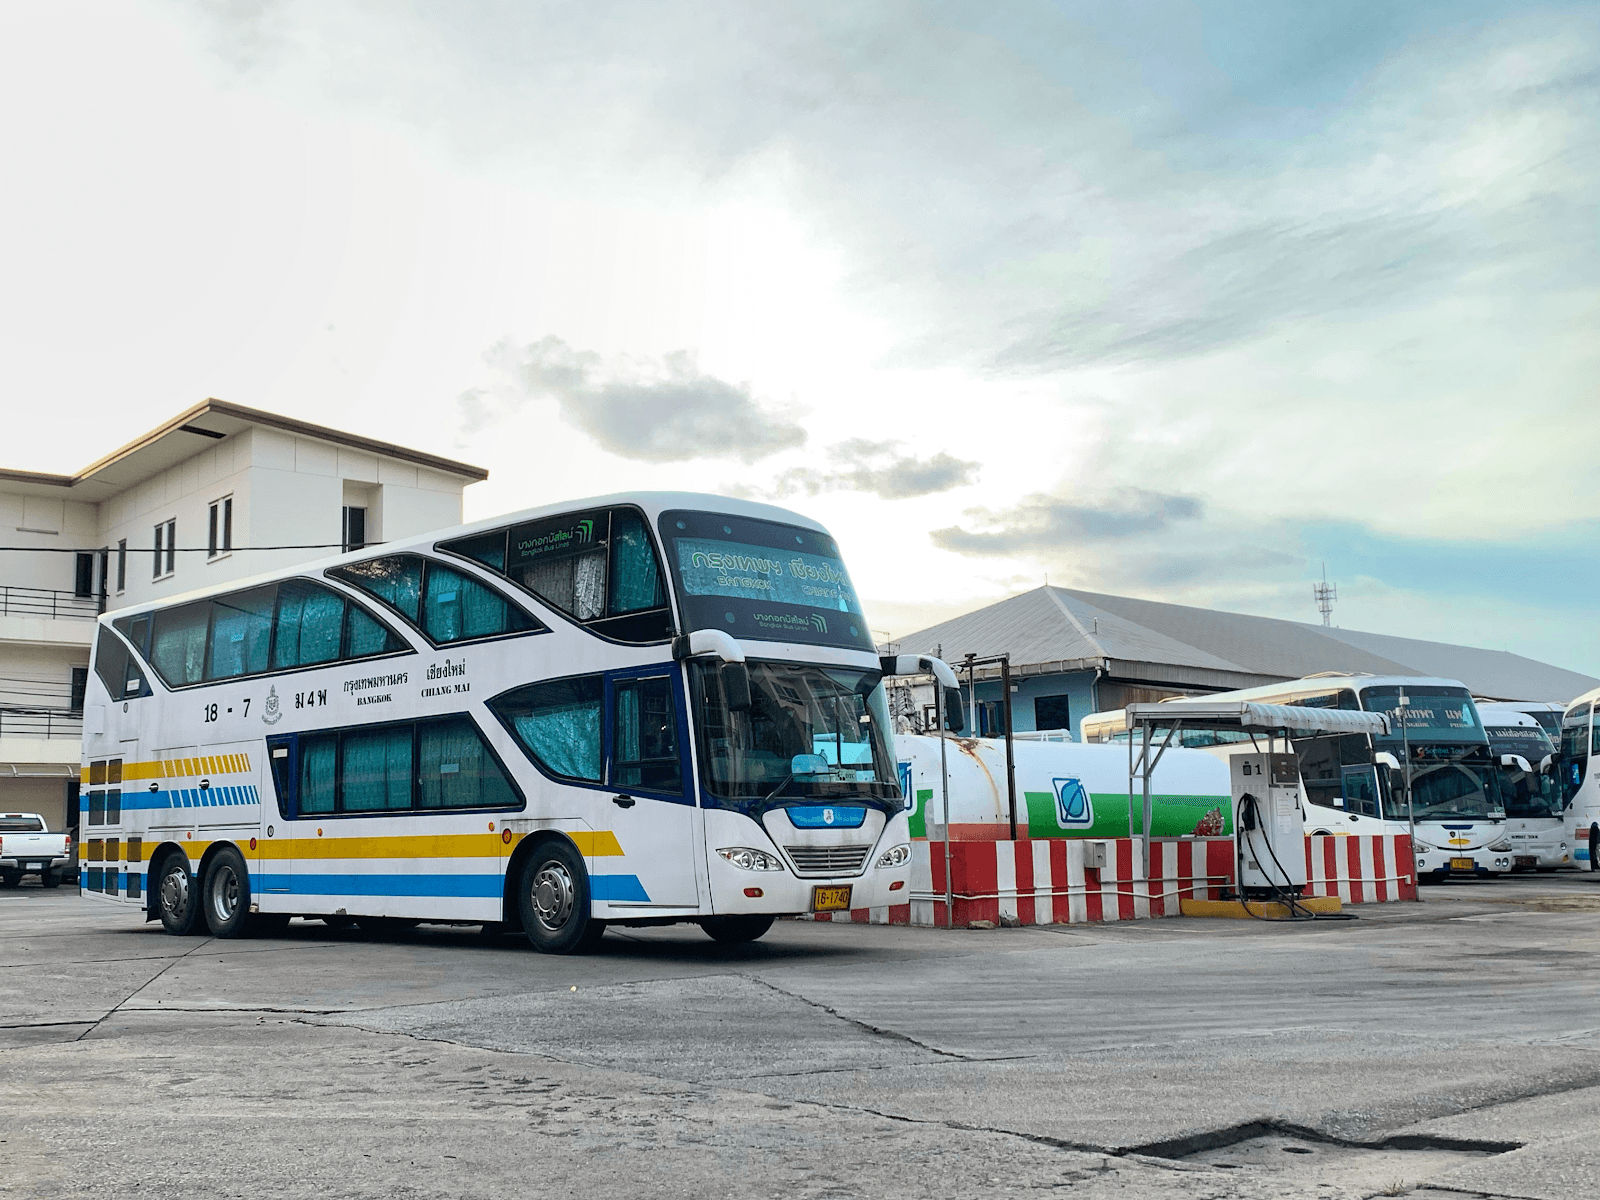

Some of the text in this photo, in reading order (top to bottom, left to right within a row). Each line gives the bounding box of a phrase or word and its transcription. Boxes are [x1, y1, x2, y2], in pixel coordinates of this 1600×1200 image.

[521, 541, 570, 557] Bangkok Bus Lines
[691, 551, 850, 587] กรุงเทพฯ เชียงใหม
[716, 575, 776, 591] BANGKOK
[343, 658, 466, 696] กรุงเทพมหานคร เชียงใหม่
[357, 682, 471, 706] BANGKOK CHIANG MAI
[204, 703, 218, 722] 18
[243, 698, 251, 718] 7
[1384, 709, 1435, 722] กุเทพฯ
[1254, 764, 1262, 775] 1
[1293, 793, 1300, 810] 1
[816, 890, 849, 905] 16-1740
